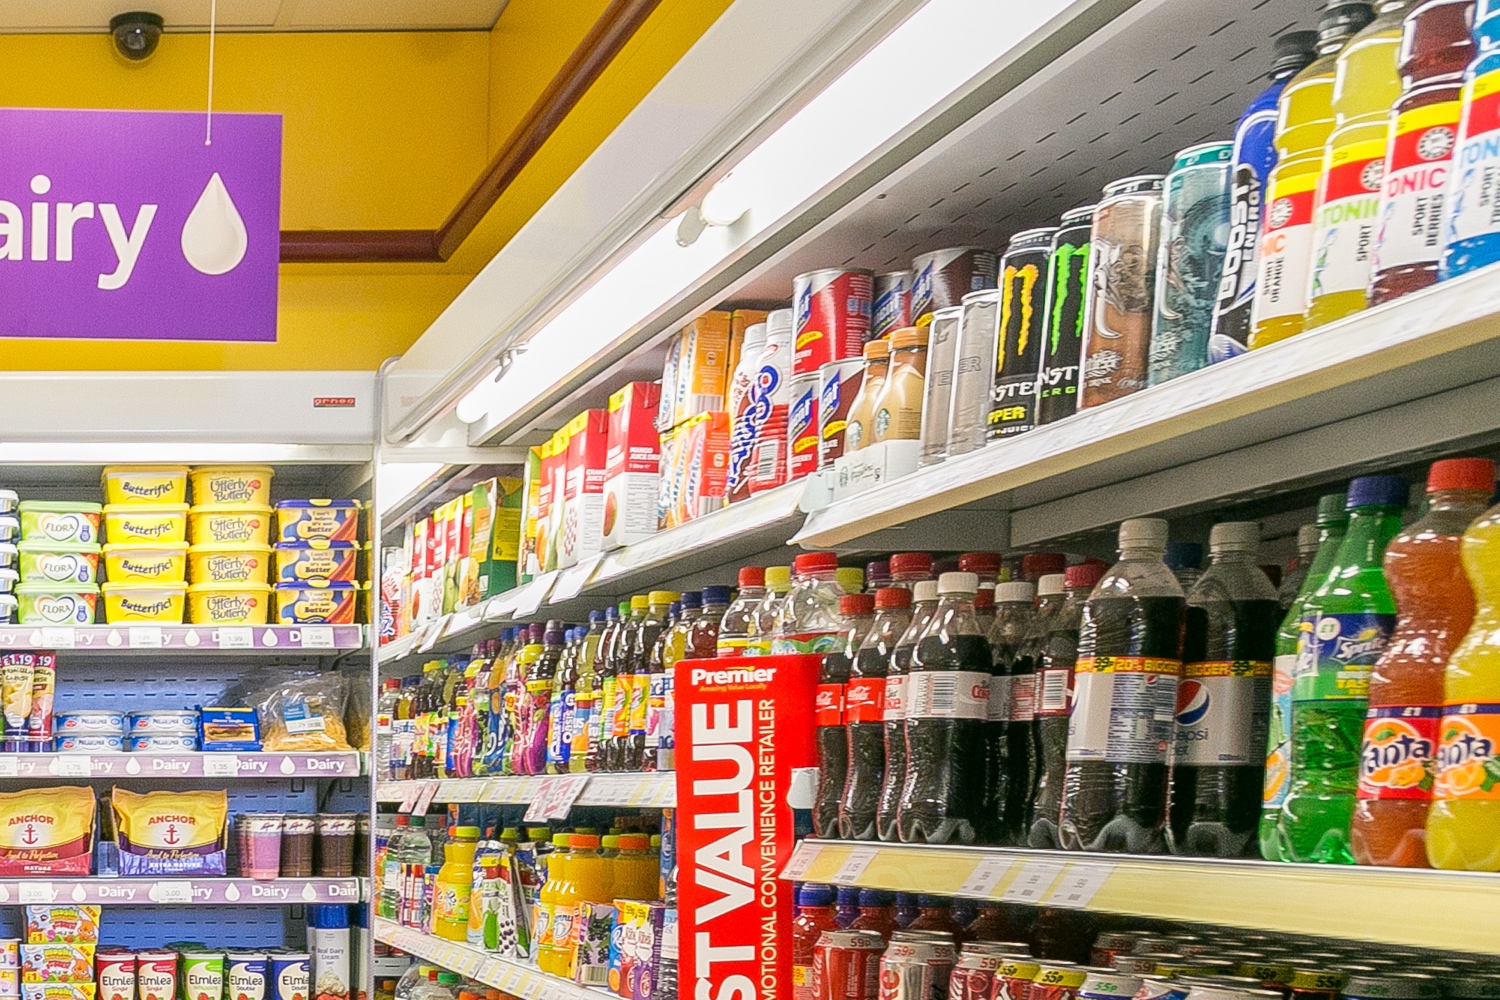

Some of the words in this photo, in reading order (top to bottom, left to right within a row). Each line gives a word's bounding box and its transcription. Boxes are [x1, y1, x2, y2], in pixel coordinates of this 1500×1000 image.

[1243, 175, 1261, 263] ENERGY
[1412, 197, 1428, 236] SPORT
[1426, 193, 1444, 247] BERRIES
[1222, 184, 1250, 300] BOOST
[1357, 224, 1372, 262] SPORT
[1271, 256, 1284, 303] ORANGE
[629, 446, 654, 454] MANGO
[210, 478, 249, 493] Utterly
[44, 521, 74, 533] FLORA
[307, 524, 332, 533] Butter
[43, 562, 73, 573] FLORA
[305, 566, 331, 574] Butter
[42, 603, 72, 614] FLORA
[1113, 659, 1142, 673] 20%
[1143, 659, 1183, 674] BIGGER
[691, 667, 776, 686] Premier
[699, 684, 726, 692] Amazing
[728, 683, 744, 691] Value
[746, 682, 767, 690] Locally
[758, 698, 775, 775] RETAILER
[306, 757, 345, 772] Dairy
[691, 699, 756, 926] VALUE
[8, 815, 54, 826] ANCHOR
[148, 814, 196, 826] ANCHOR
[760, 777, 778, 906] CONVENIENCE
[102, 976, 134, 985] Elmlea
[139, 976, 171, 985] Elmlea
[190, 975, 221, 984] Elmlea
